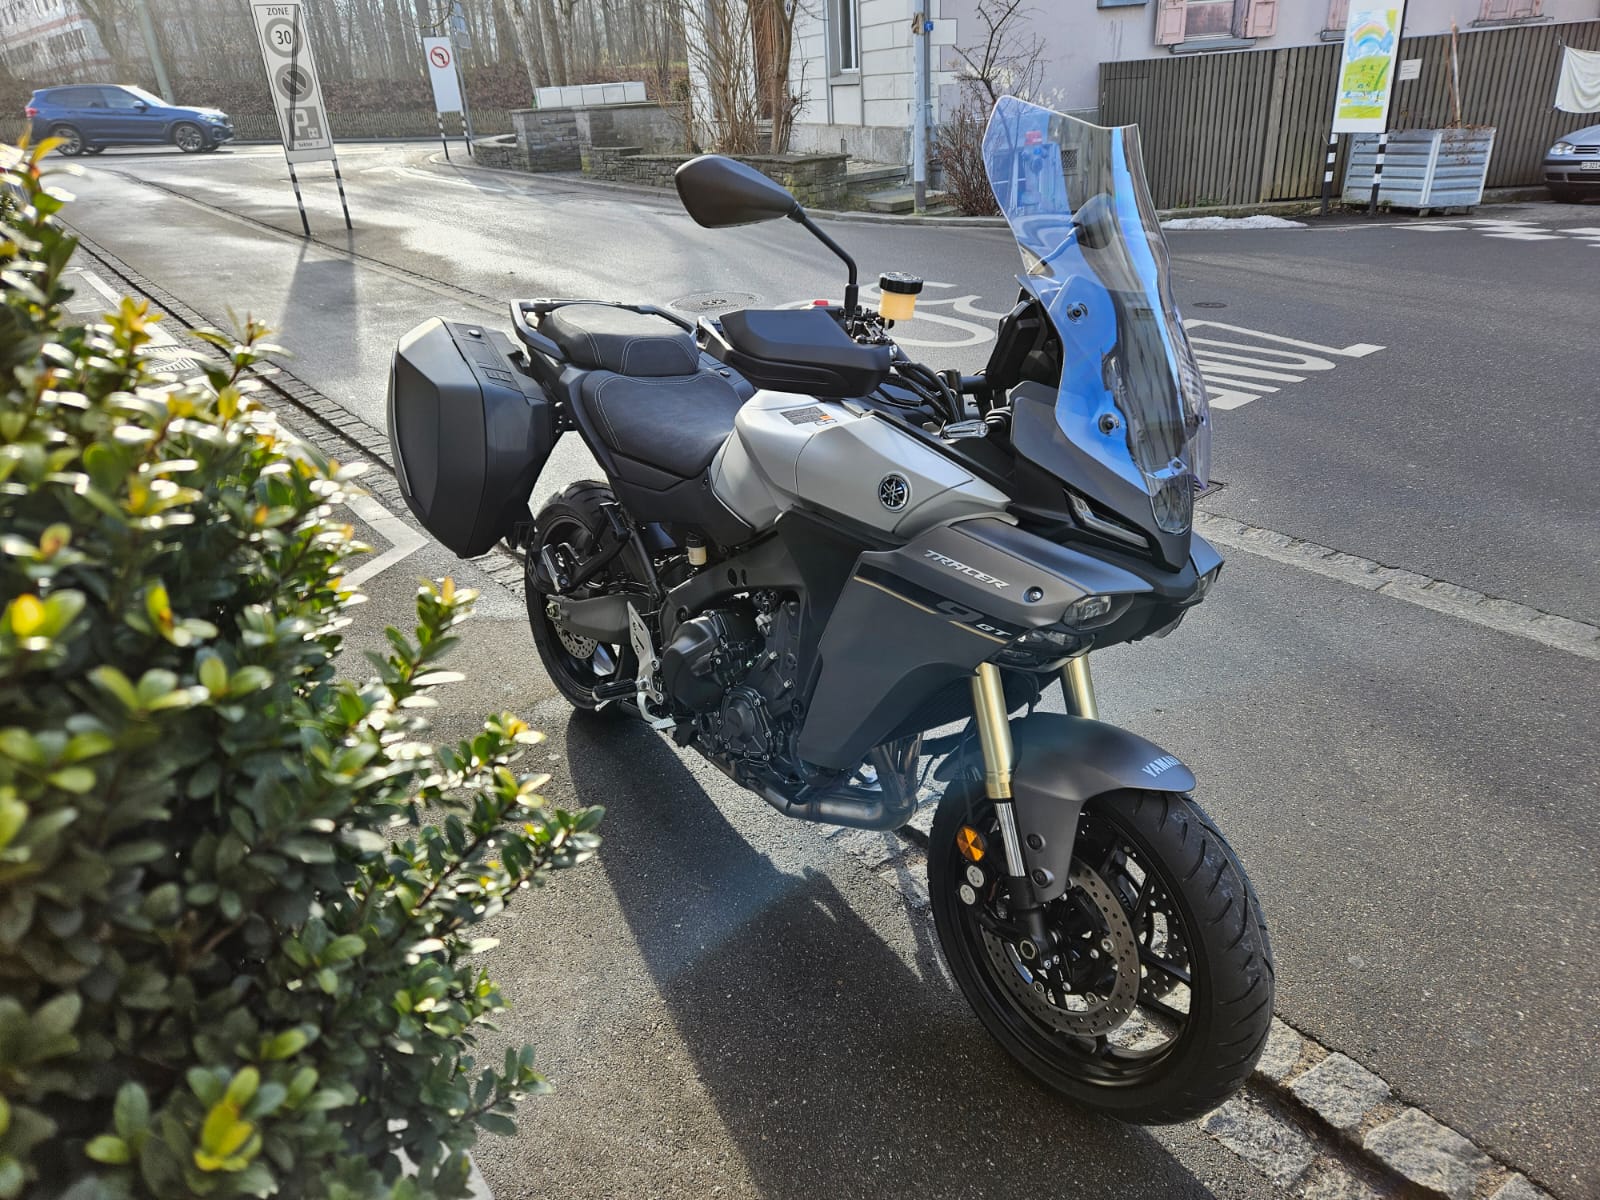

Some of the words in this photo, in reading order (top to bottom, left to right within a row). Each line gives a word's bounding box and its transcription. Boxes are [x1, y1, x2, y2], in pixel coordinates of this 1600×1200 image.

[266, 7, 290, 16] ZONE
[275, 30, 292, 45] 30
[290, 108, 309, 137] P
[923, 550, 1011, 590] TRACER
[975, 623, 1013, 637] GT
